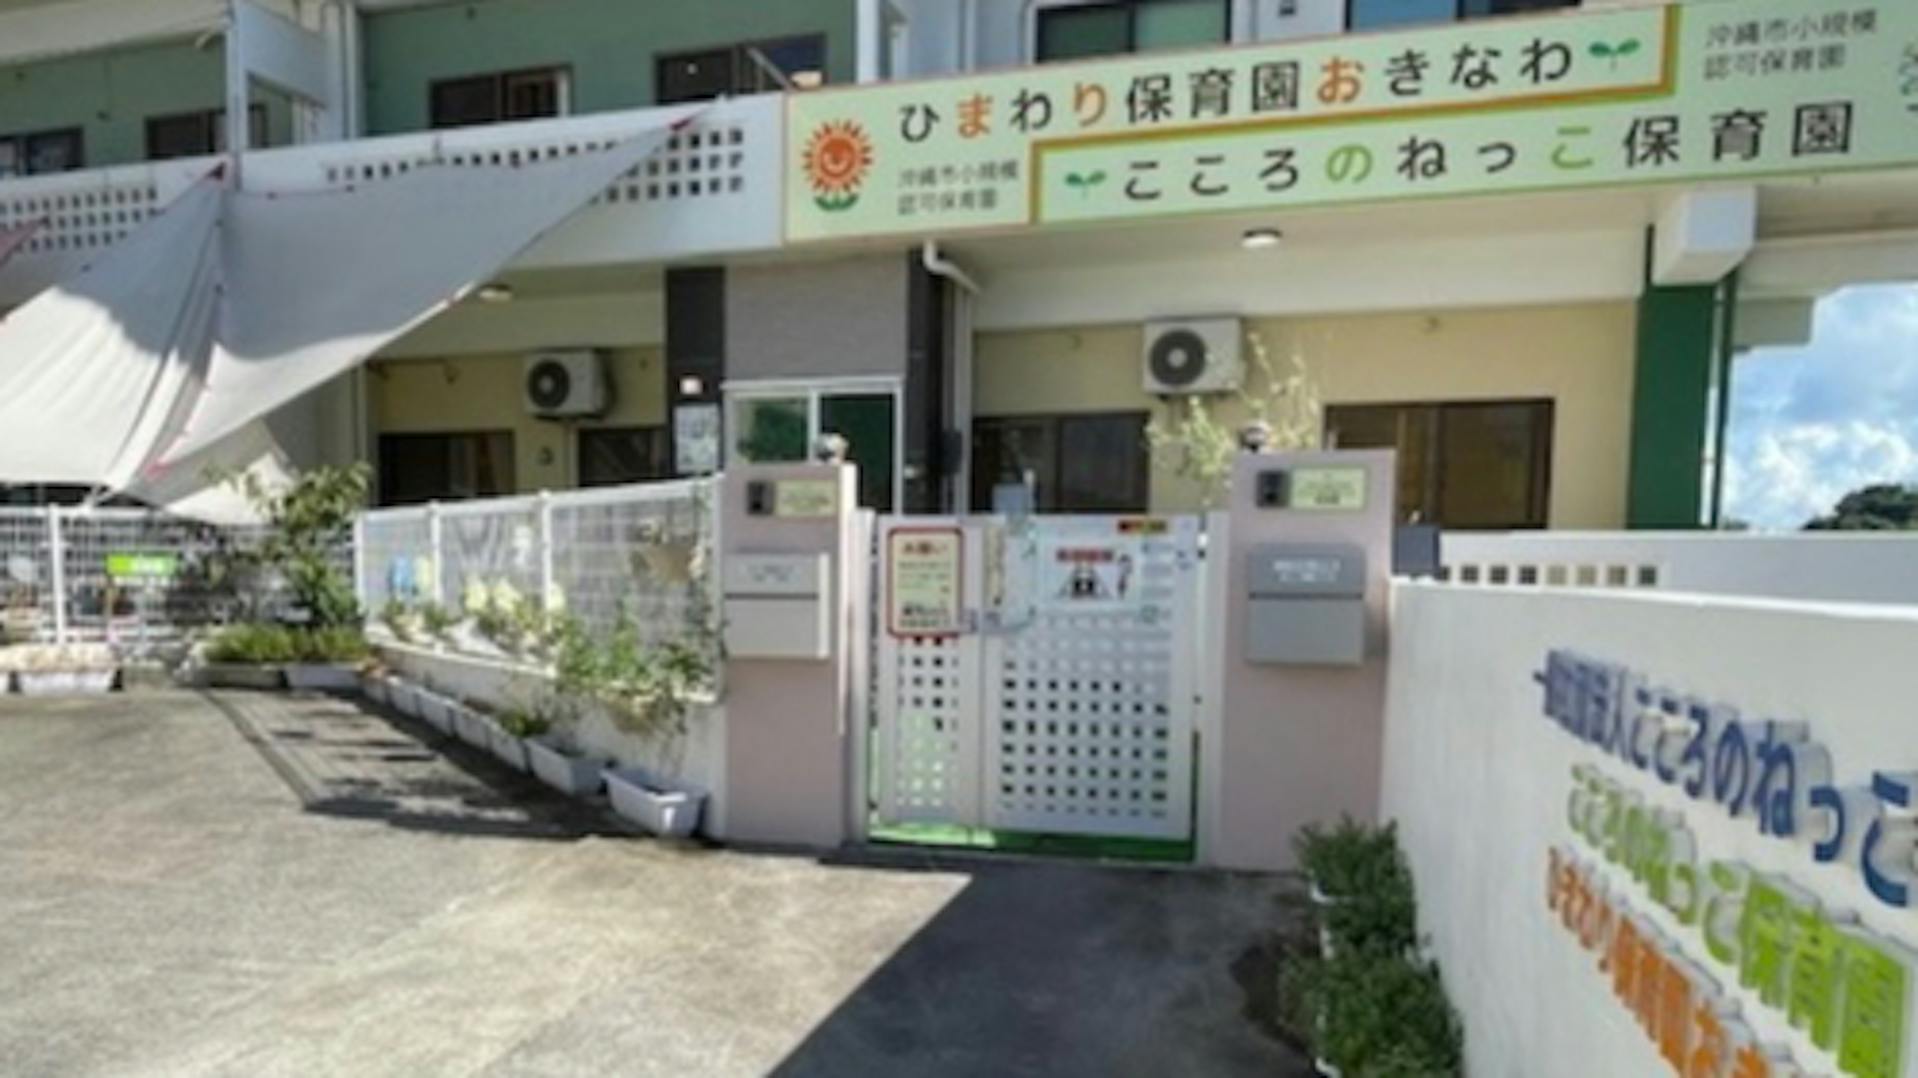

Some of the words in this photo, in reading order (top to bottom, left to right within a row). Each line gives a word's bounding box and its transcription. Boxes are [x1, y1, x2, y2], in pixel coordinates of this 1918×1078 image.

[899, 39, 1573, 143] ひまわり保育園おきなわ
[1124, 102, 1853, 200] こころのねっこ保育園
